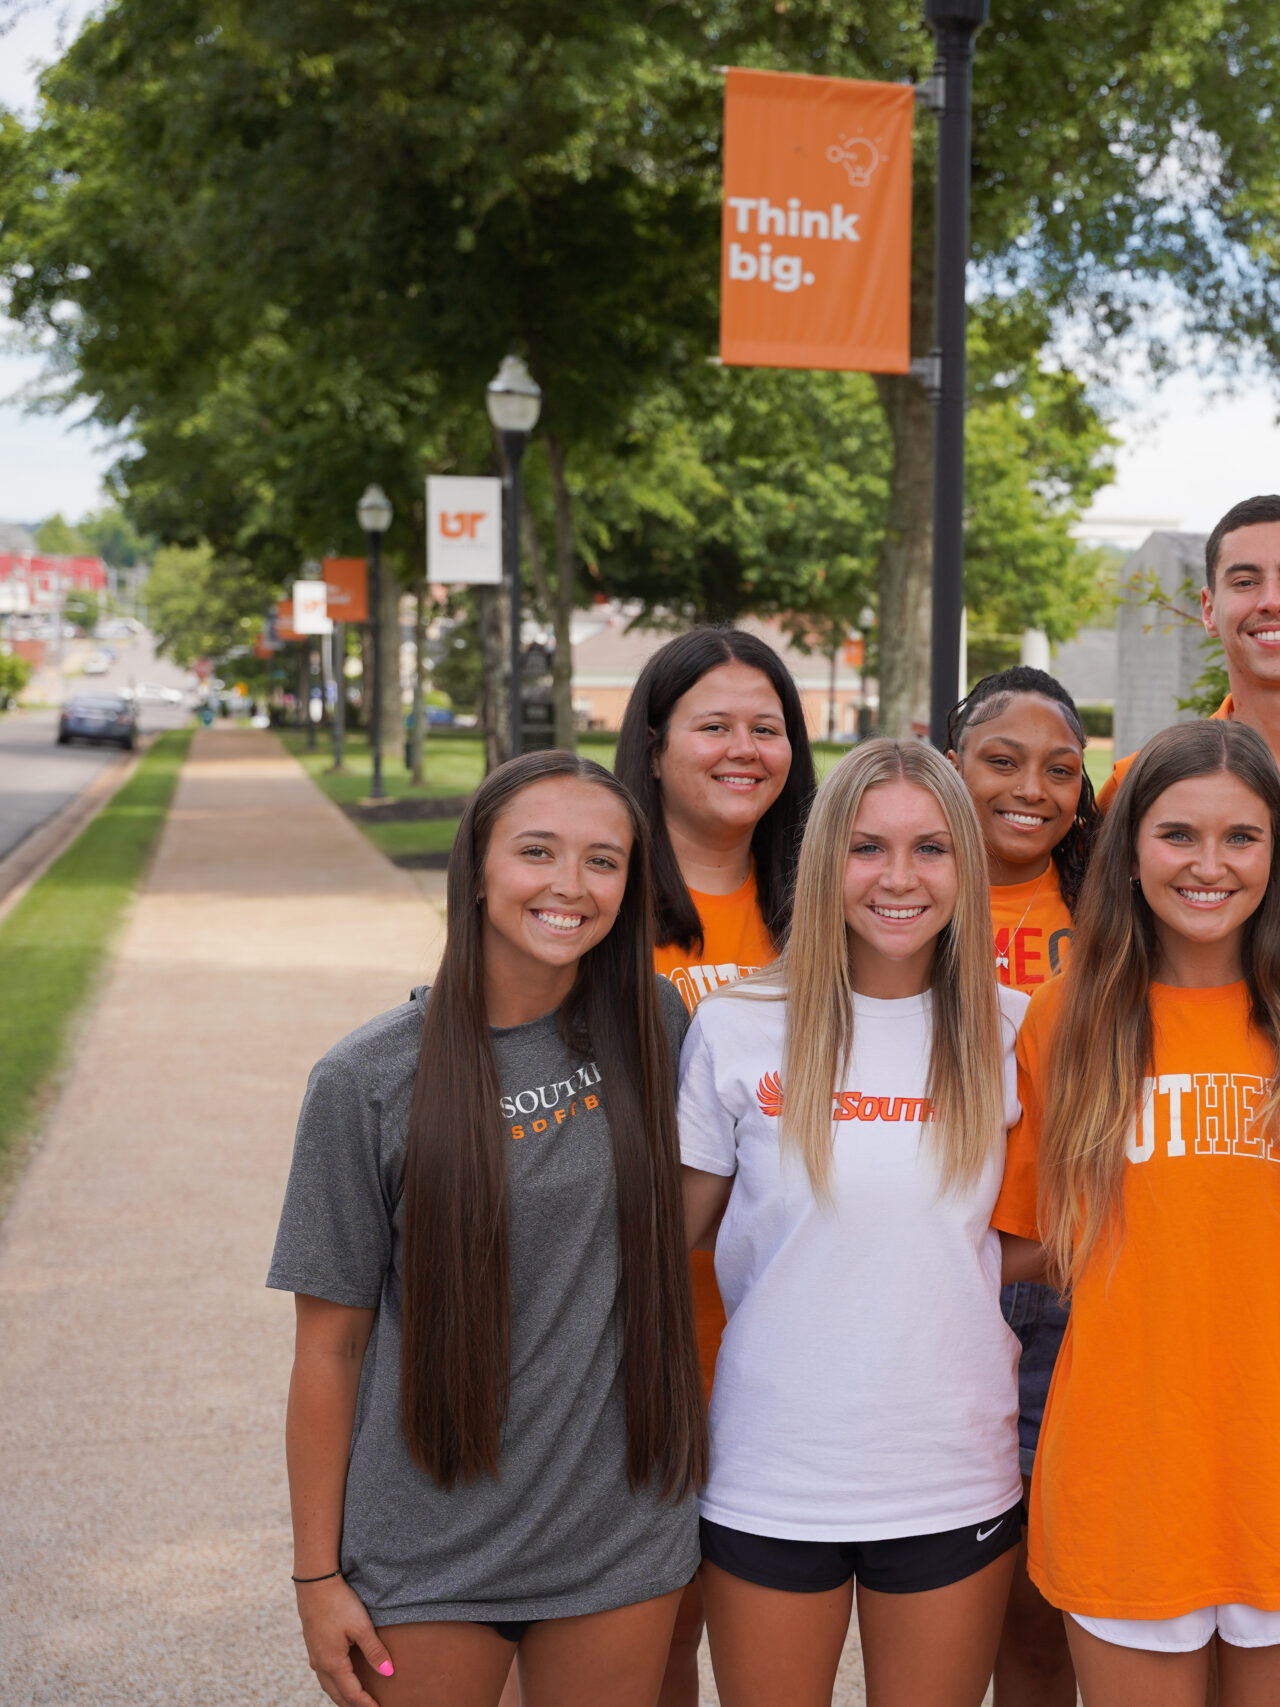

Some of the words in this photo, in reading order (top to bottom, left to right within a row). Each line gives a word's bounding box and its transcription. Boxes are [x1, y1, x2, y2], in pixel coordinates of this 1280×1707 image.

[728, 196, 861, 242] Think
[729, 243, 815, 292] big.
[438, 510, 487, 540] UT
